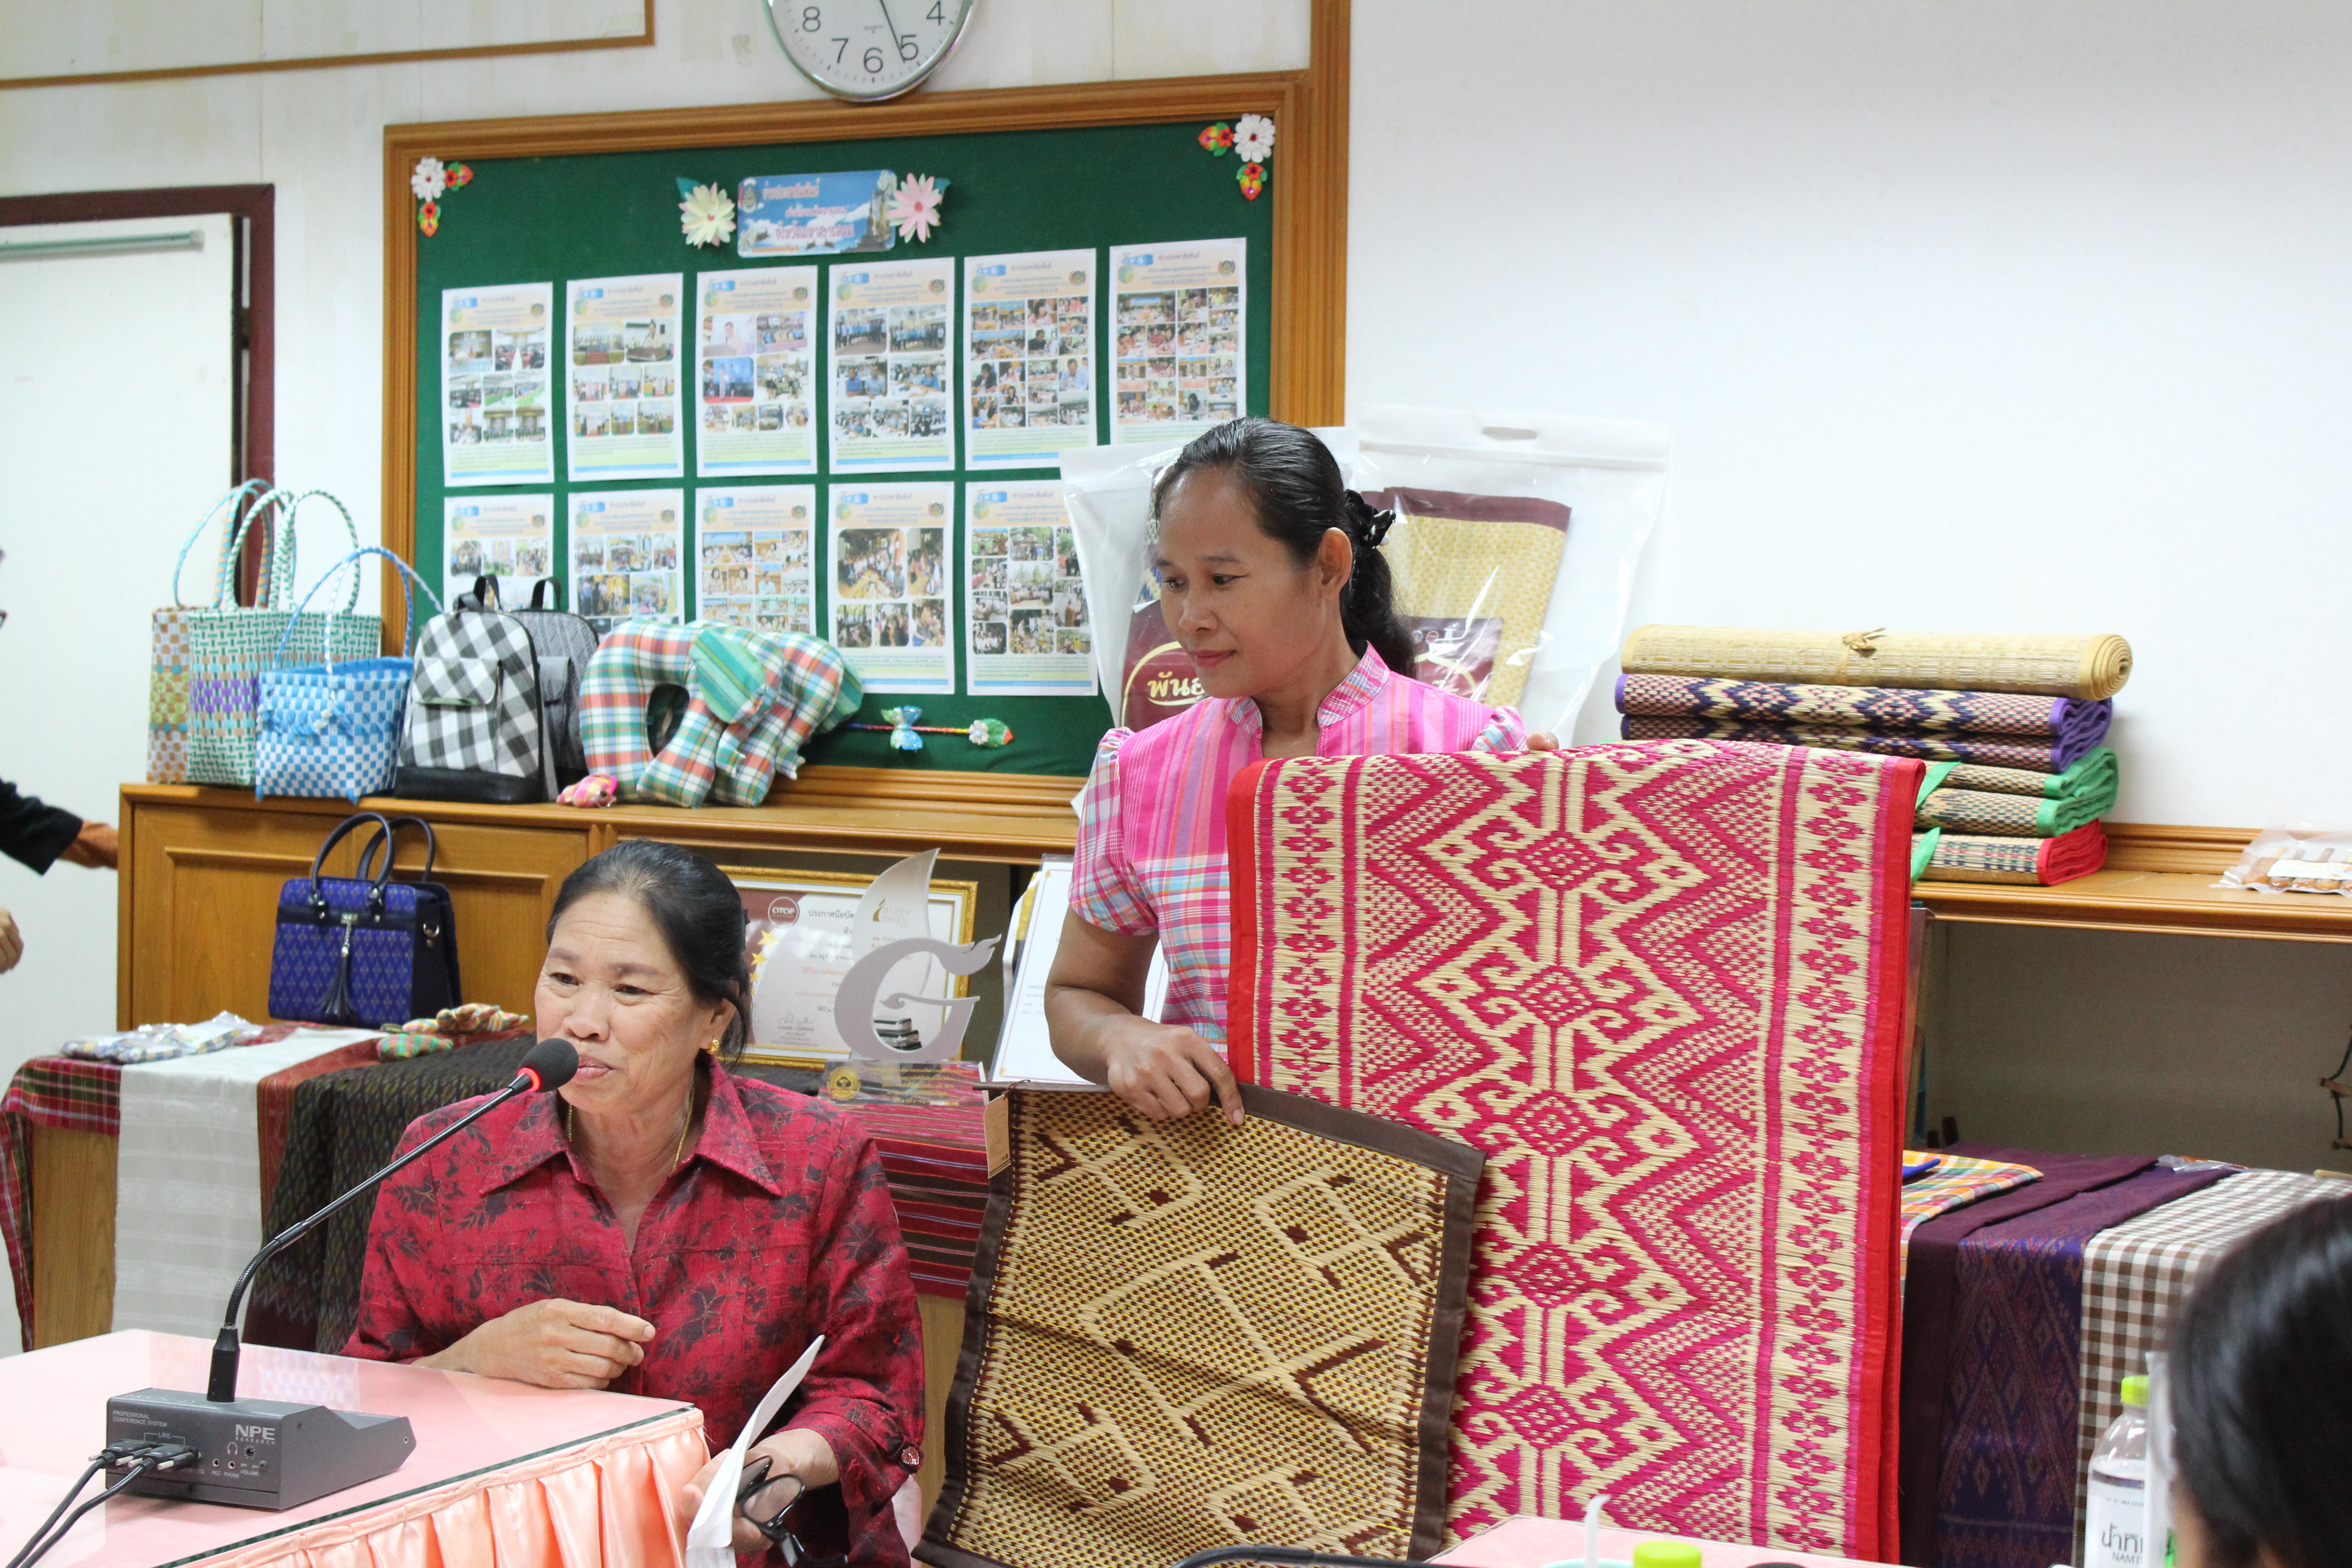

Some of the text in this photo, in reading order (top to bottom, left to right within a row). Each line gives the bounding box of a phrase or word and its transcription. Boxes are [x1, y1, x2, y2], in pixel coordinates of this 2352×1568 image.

[802, 7, 821, 32] 8
[926, 1, 946, 26] 4
[831, 38, 849, 64] 7
[900, 34, 919, 61] 5
[863, 48, 883, 74] 6
[772, 906, 795, 915] OTOP
[808, 909, 854, 919] ประกาศนียบัต
[113, 1410, 149, 1419] PROFESSIONAL
[113, 1416, 146, 1426] CONFERENCE
[235, 1424, 275, 1441] NPE
[235, 1436, 275, 1445] RESEARCH
[2102, 1523, 2142, 1554] น้ำทิ
